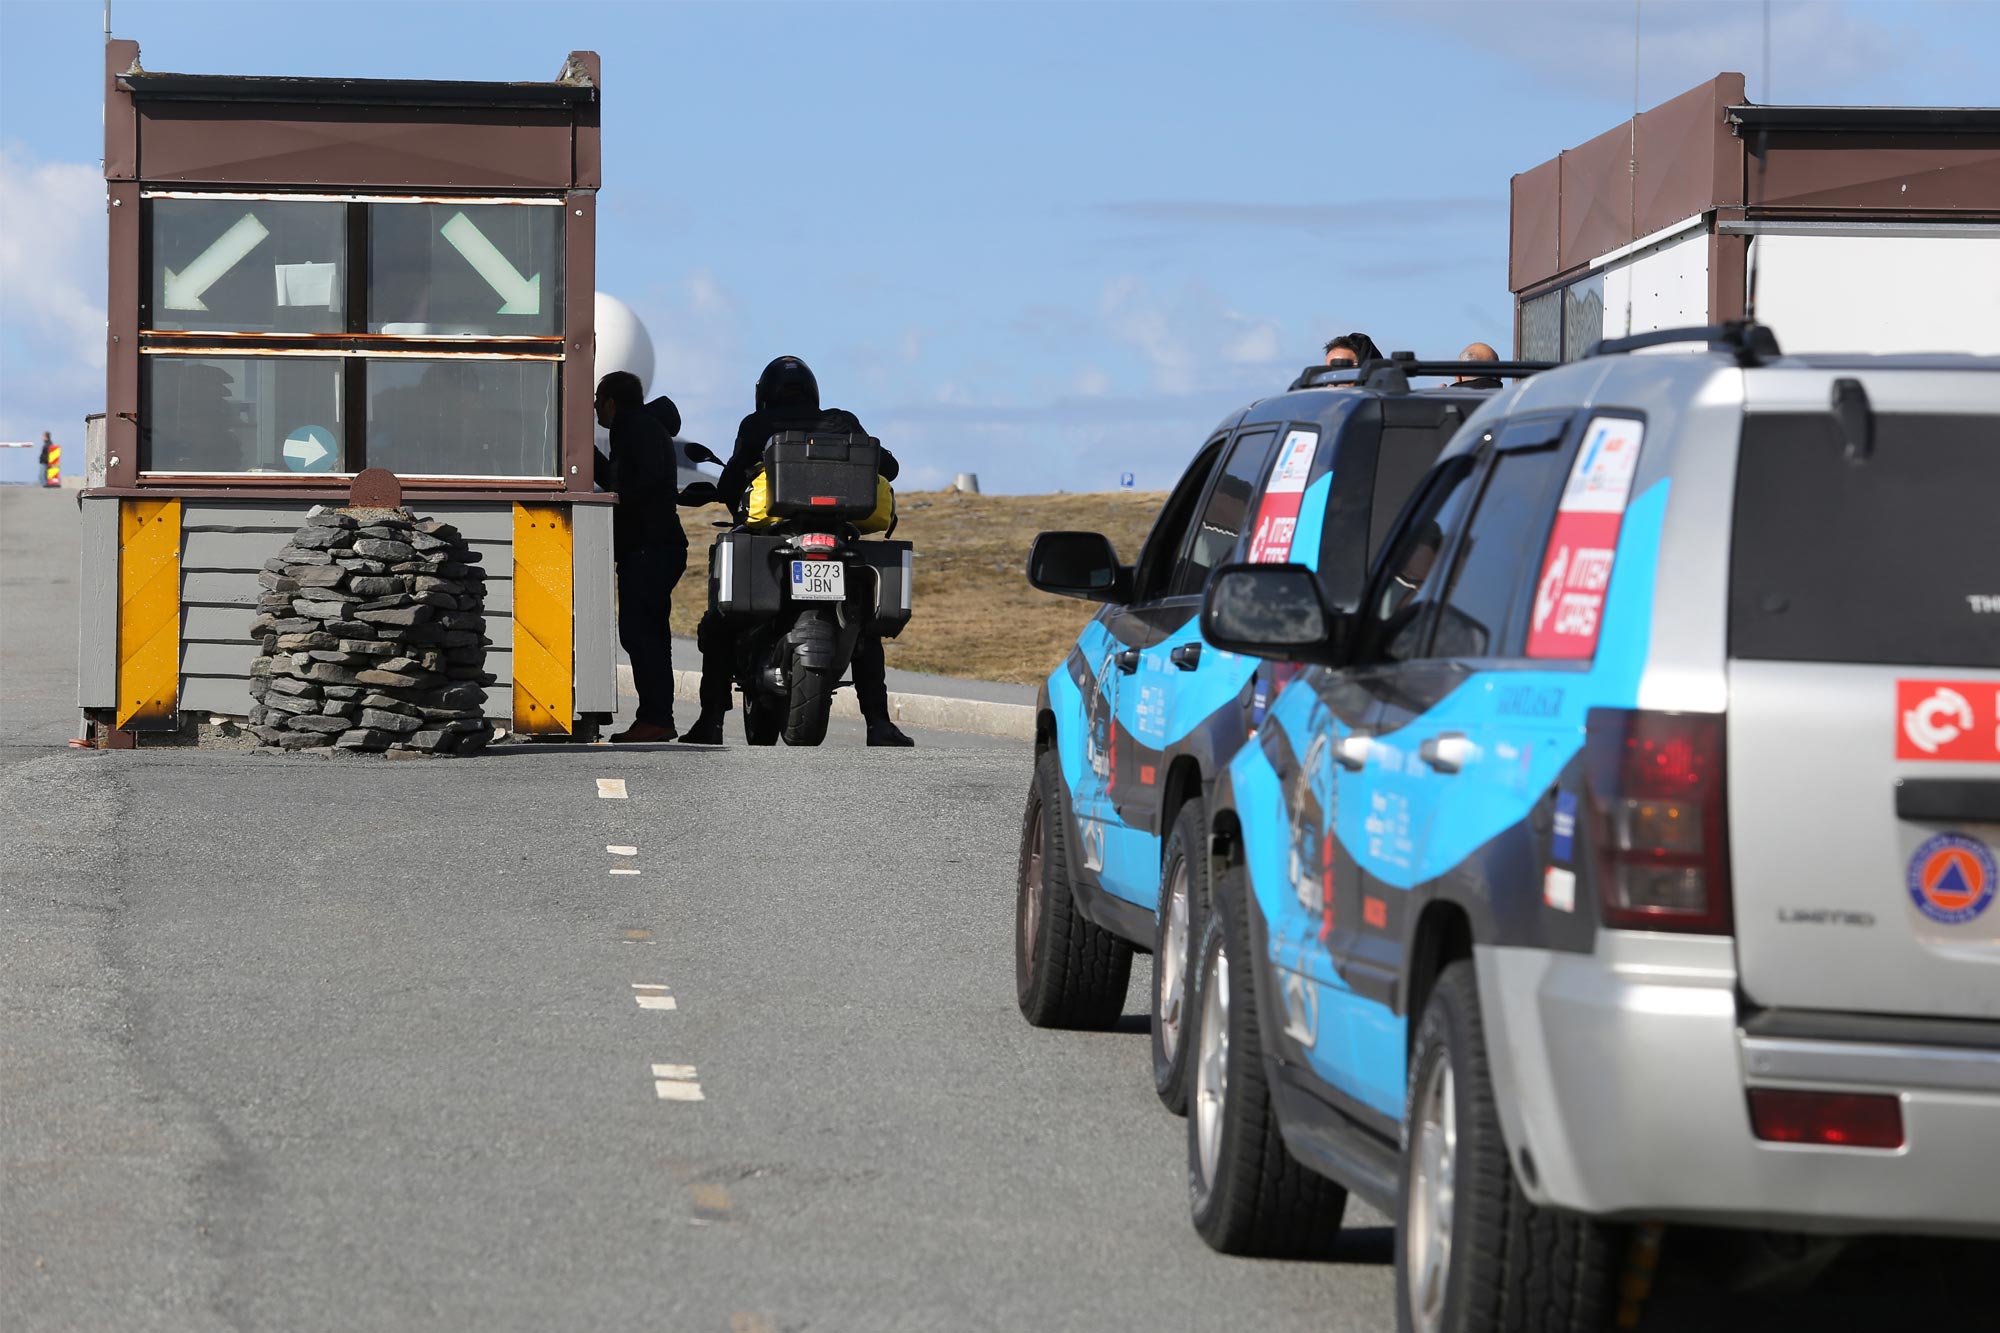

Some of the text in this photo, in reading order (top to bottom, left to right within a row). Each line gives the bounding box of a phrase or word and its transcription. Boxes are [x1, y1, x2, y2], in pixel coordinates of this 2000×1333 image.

[804, 564, 840, 578] 3273
[805, 579, 832, 593] JBN
[1966, 594, 2000, 613] TH
[1554, 592, 1602, 636] CARS
